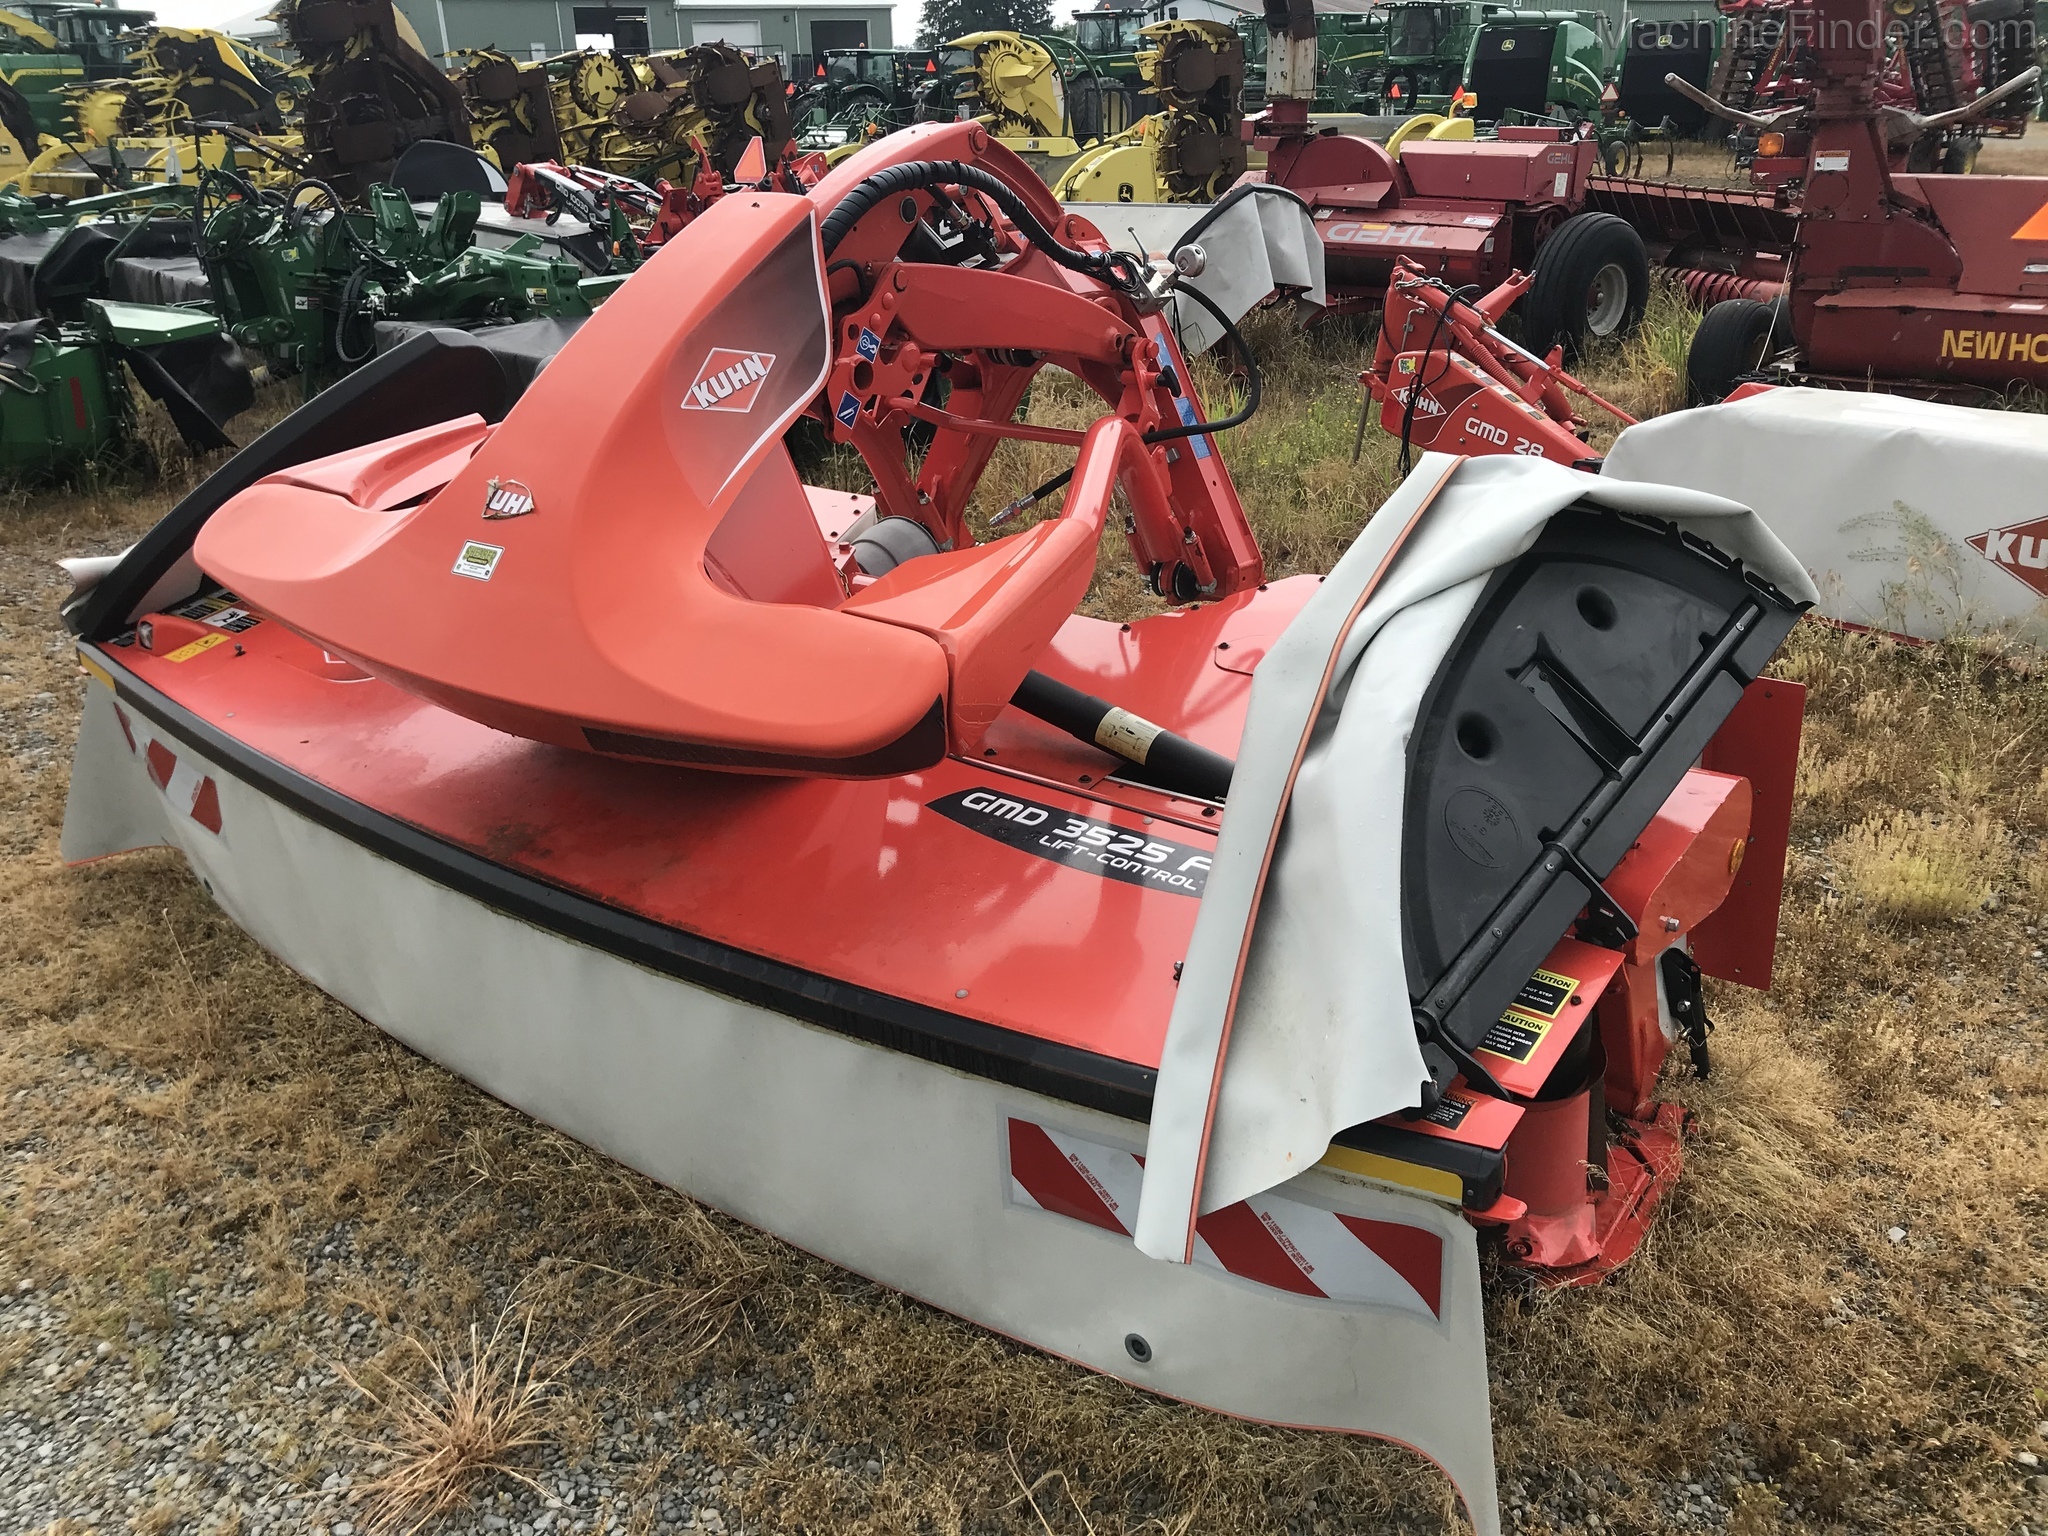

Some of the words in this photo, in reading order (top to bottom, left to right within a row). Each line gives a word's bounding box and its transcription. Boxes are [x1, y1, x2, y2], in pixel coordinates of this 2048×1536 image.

[1547, 153, 1574, 165] GEHL
[1326, 223, 1434, 246] GEHL
[1941, 329, 2006, 360] NEW
[691, 352, 767, 409] KUHN
[1399, 388, 1439, 415] KHN
[1465, 416, 1509, 446] GMD
[961, 792, 1049, 826] GMD
[1052, 818, 1176, 863] 3525
[1532, 973, 1571, 988] AUTION
[1529, 995, 1554, 1006] MACHINE
[1442, 1092, 1474, 1105] ARNING
